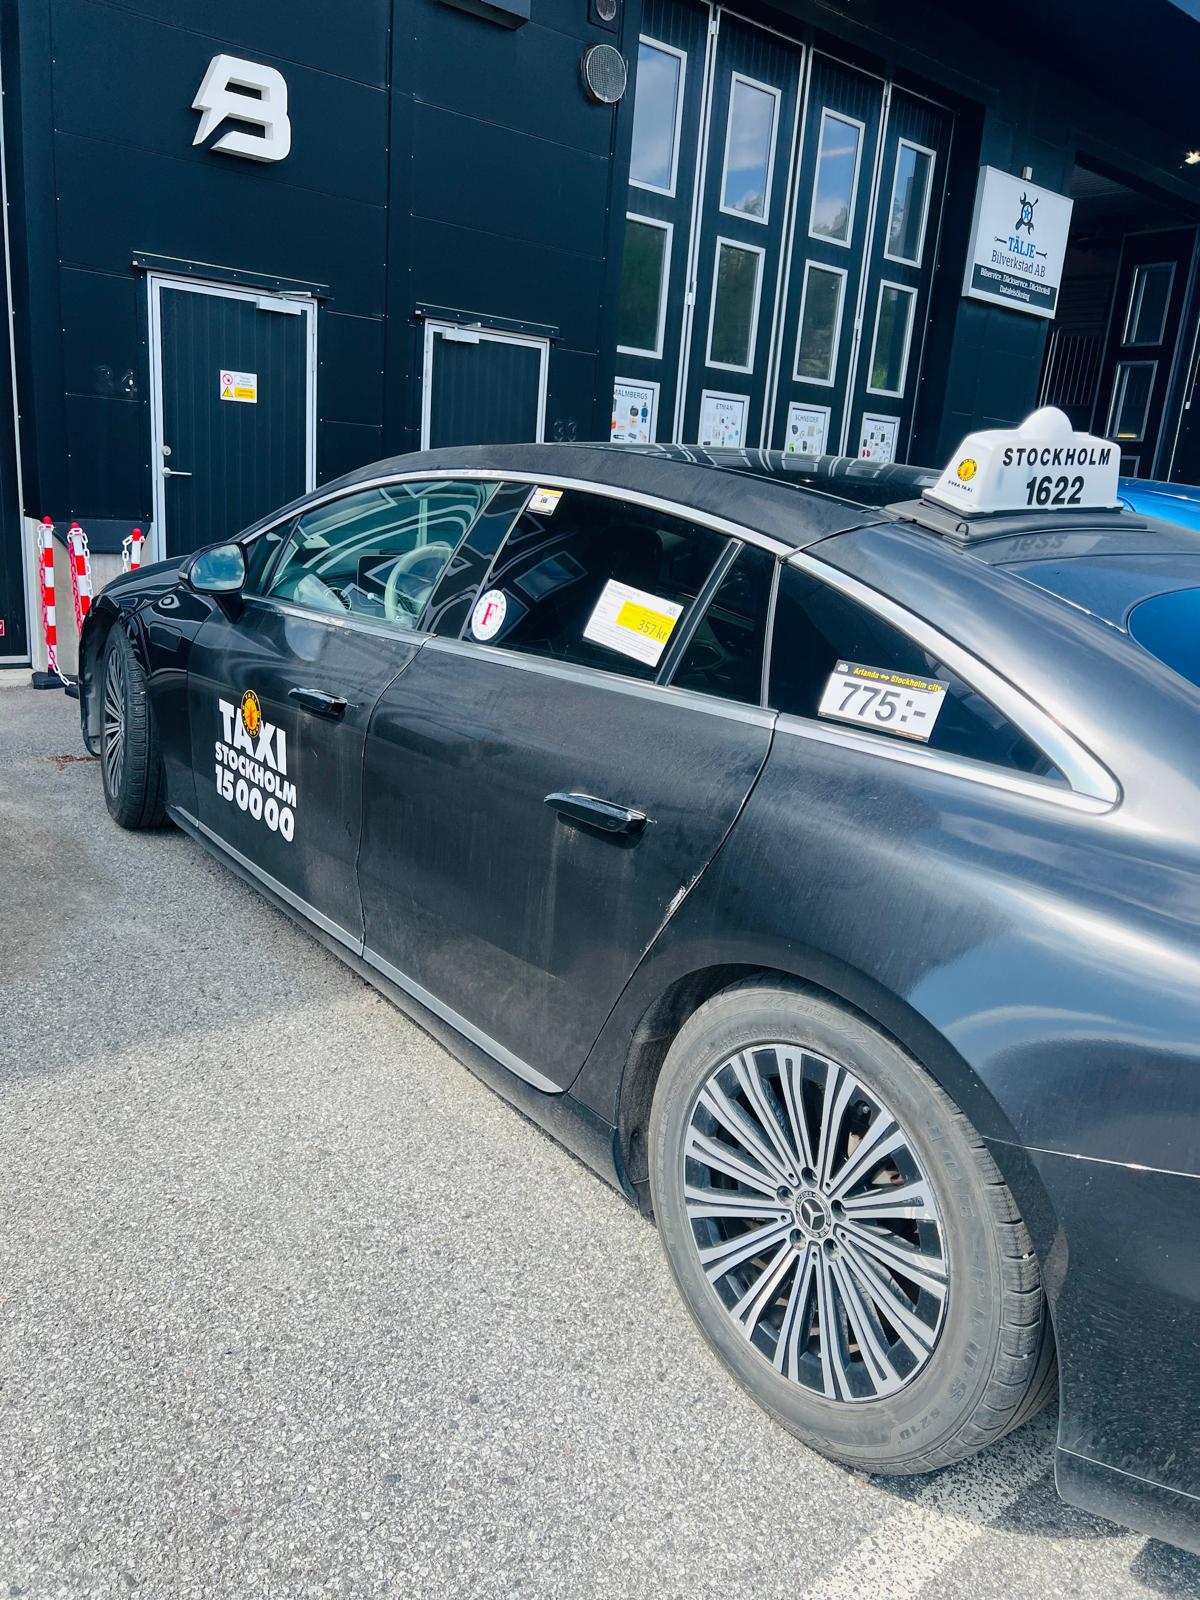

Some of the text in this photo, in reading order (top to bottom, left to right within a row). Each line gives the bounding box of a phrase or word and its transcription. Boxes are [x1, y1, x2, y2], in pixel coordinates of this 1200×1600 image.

[1008, 236, 1036, 259] TÄLJE
[991, 250, 1046, 278] Bilverkstad AB
[1002, 447, 1111, 467] STOCKHOLM
[1026, 475, 1085, 506] 1622
[480, 602, 498, 625] F
[639, 620, 668, 640] 357 kr
[853, 667, 880, 680] Arlanda
[890, 675, 927, 689] Stockholm
[928, 683, 943, 693] city
[838, 681, 926, 723] 775:-
[218, 698, 288, 776] TAXI
[215, 741, 297, 808] STOCKHOLM
